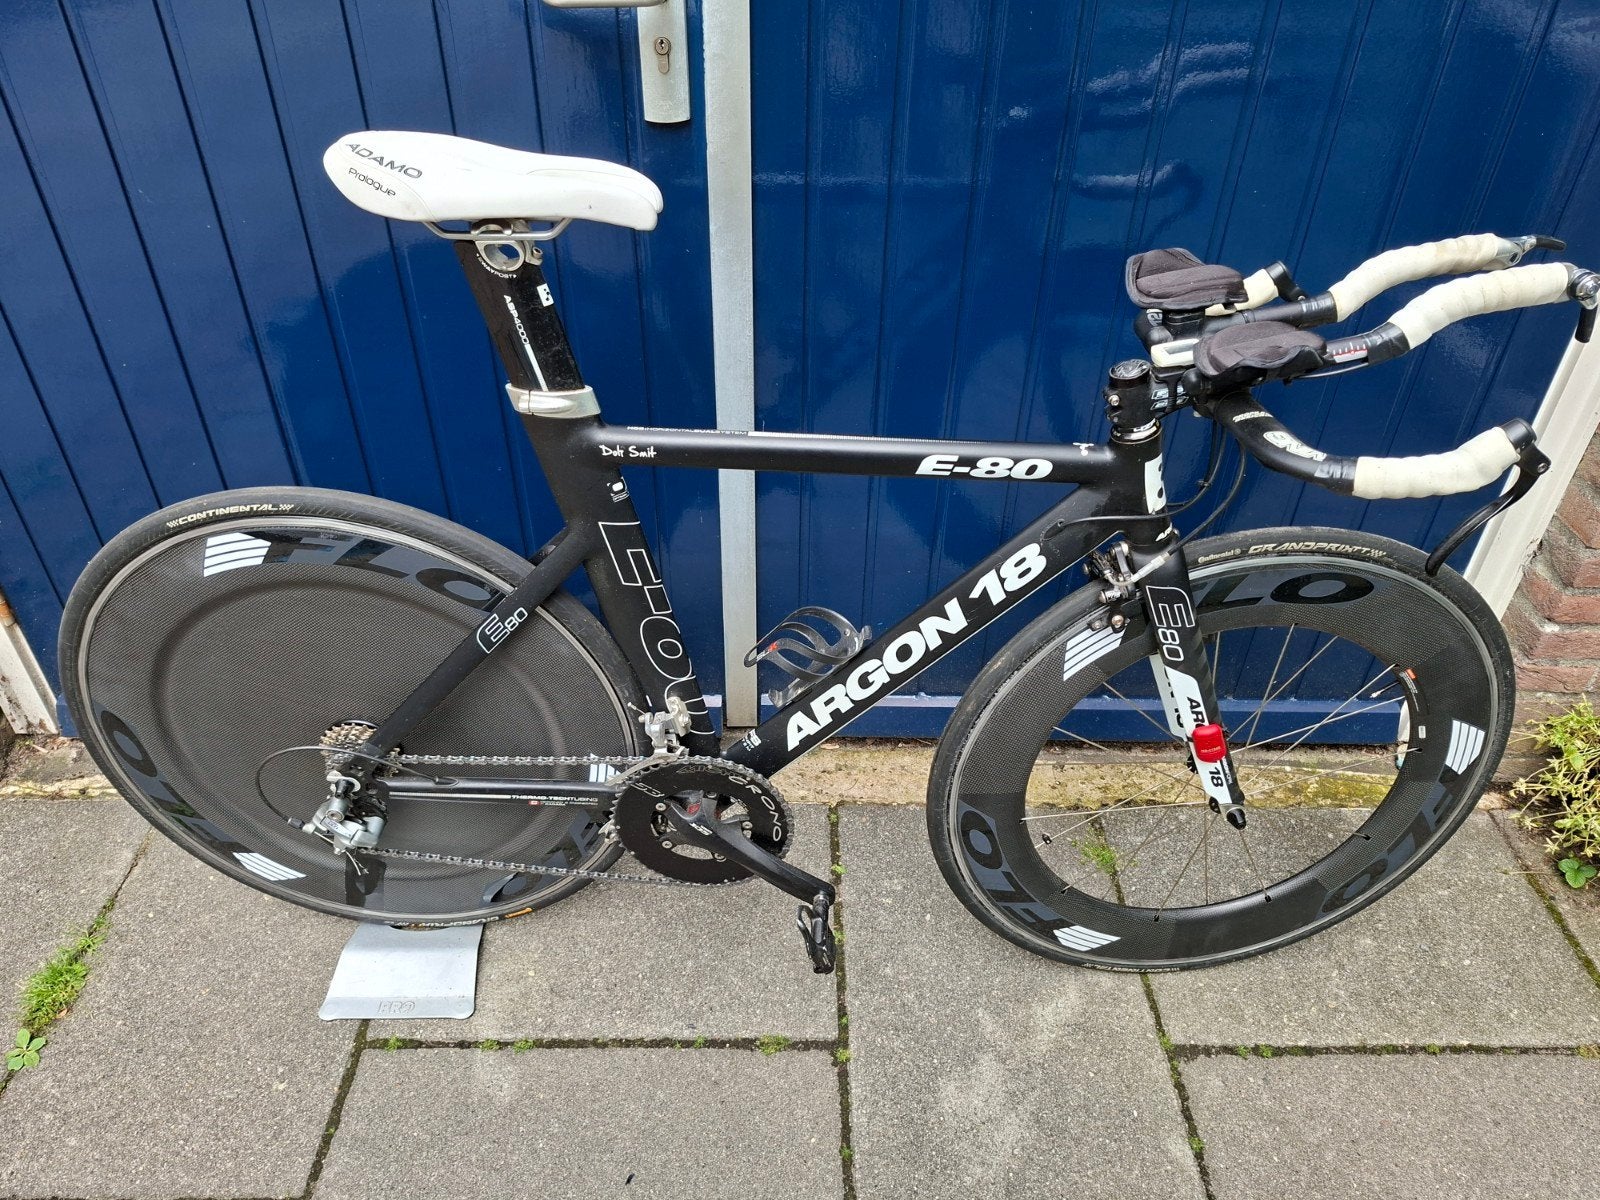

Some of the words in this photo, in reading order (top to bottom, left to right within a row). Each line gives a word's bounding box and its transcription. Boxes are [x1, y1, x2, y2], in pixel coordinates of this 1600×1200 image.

[345, 143, 423, 179] ADAMO
[348, 166, 396, 197] Prologue
[629, 445, 657, 458] Smit
[915, 454, 1053, 480] E-80
[178, 503, 278, 524] CONTINENTAL
[1198, 550, 1235, 564] Continental
[476, 606, 529, 654] E80
[1146, 585, 1195, 662] E80
[787, 597, 969, 752] ARGON
[969, 543, 1047, 606] 18
[1209, 765, 1224, 788] 18
[728, 776, 782, 842] CRONO
